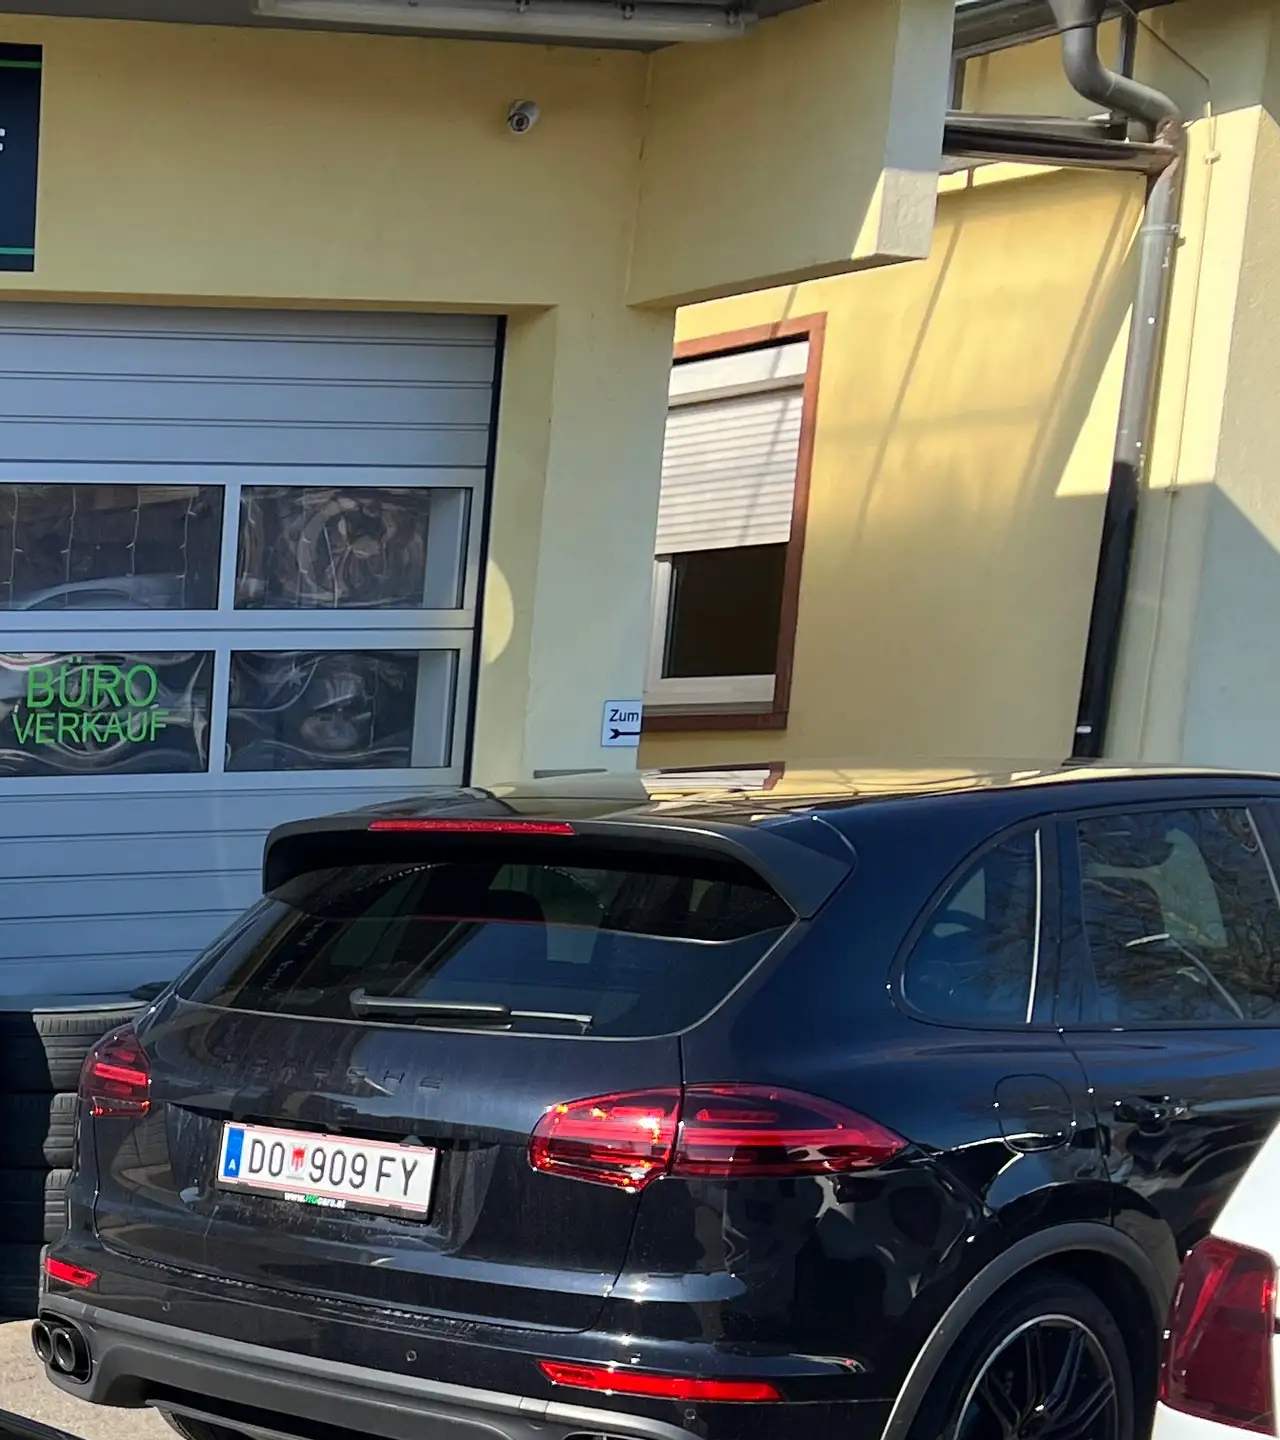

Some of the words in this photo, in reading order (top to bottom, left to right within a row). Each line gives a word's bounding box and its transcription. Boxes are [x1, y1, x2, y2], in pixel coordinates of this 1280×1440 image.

[26, 656, 159, 708] BÜRO
[12, 709, 169, 744] VERKAUF
[609, 709, 639, 722] Zum
[248, 1138, 286, 1177] DO
